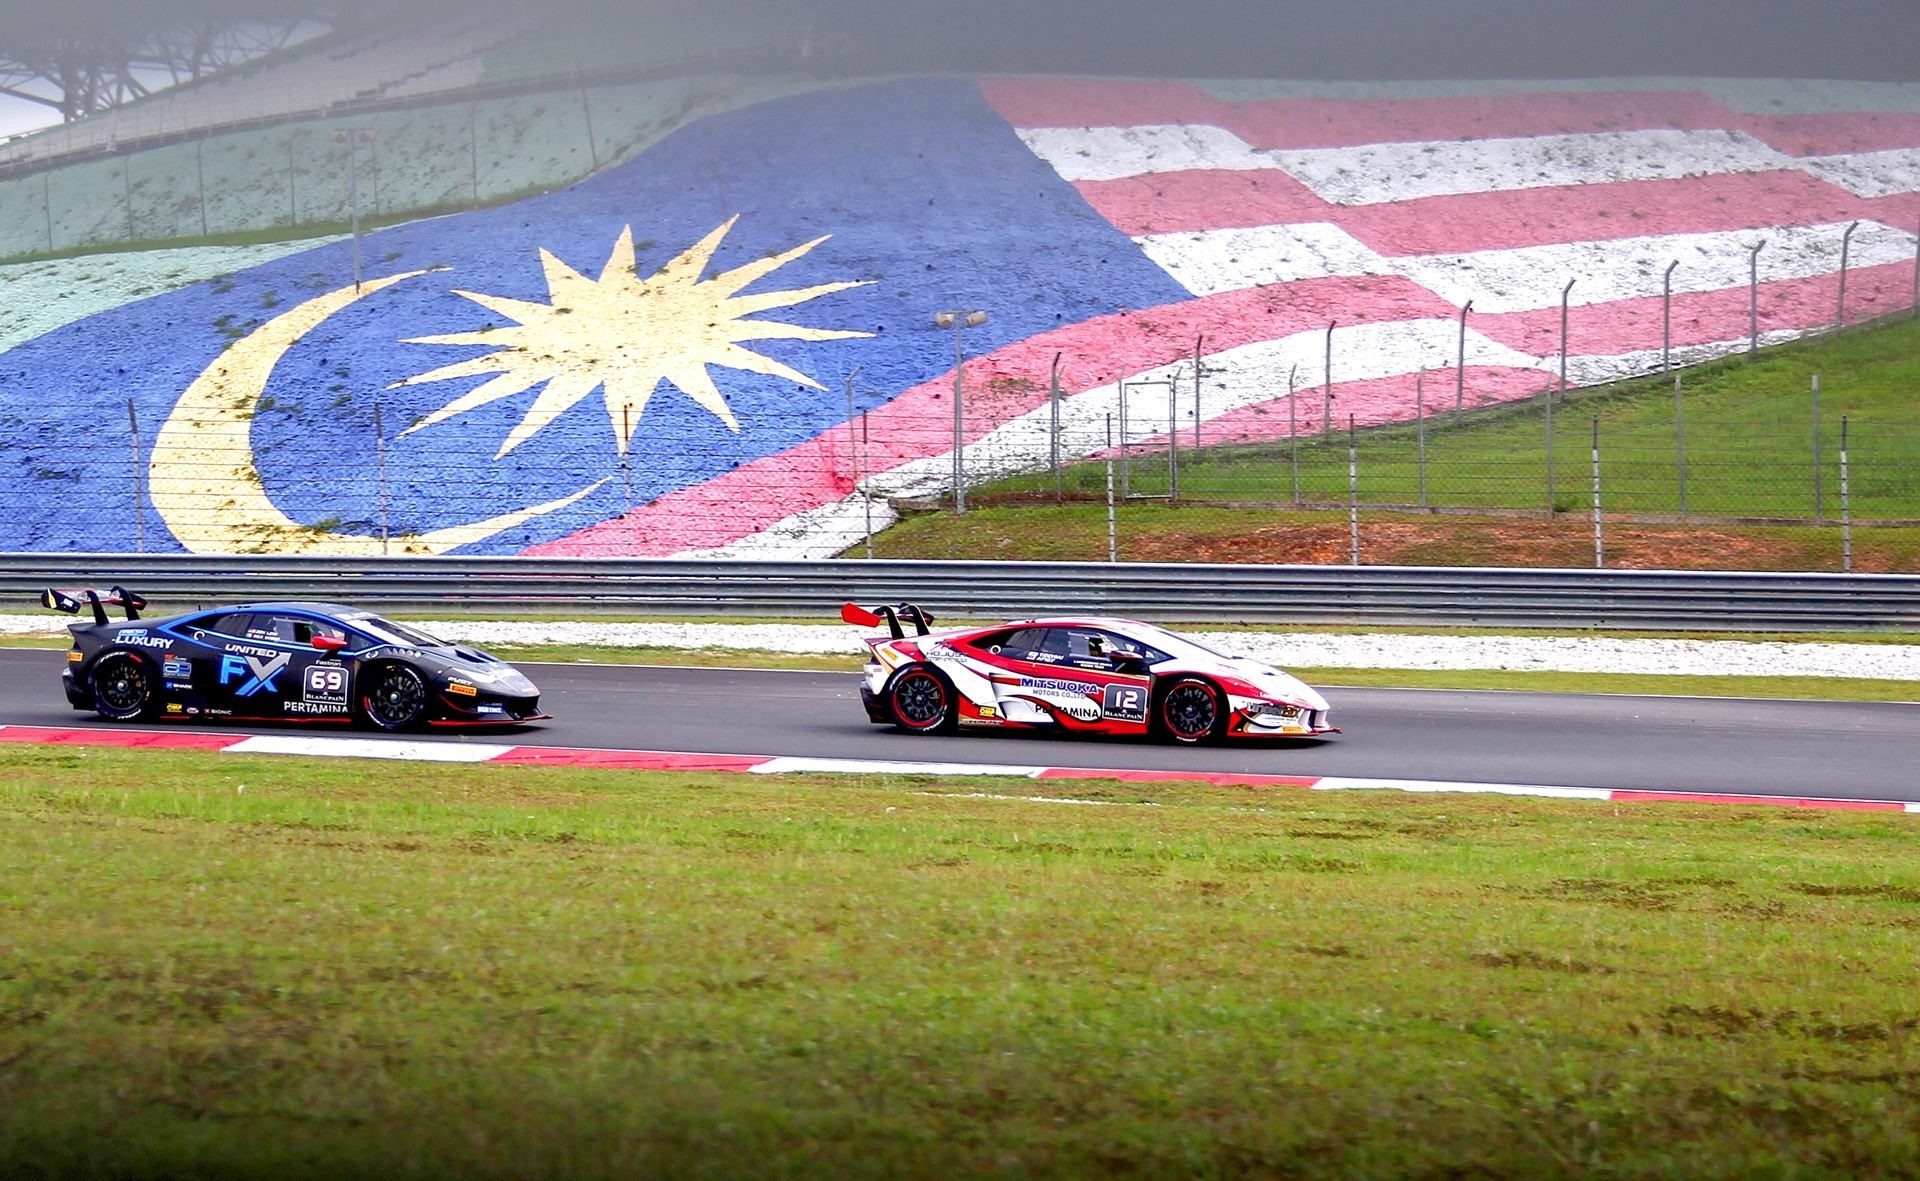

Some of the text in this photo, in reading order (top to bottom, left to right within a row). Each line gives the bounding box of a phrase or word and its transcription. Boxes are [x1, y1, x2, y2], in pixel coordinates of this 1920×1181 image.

[114, 635, 174, 649] LUXURY
[224, 644, 277, 658] UNITED
[220, 651, 292, 697] FX
[311, 671, 342, 690] 69
[1021, 678, 1099, 694] MITSUOKA
[1032, 689, 1060, 697] MOTORS
[306, 693, 345, 702] BLANCPAIN
[1116, 690, 1139, 709] 12
[283, 701, 348, 713] PERTAMINA
[1105, 710, 1143, 720] BLANCPAIN
